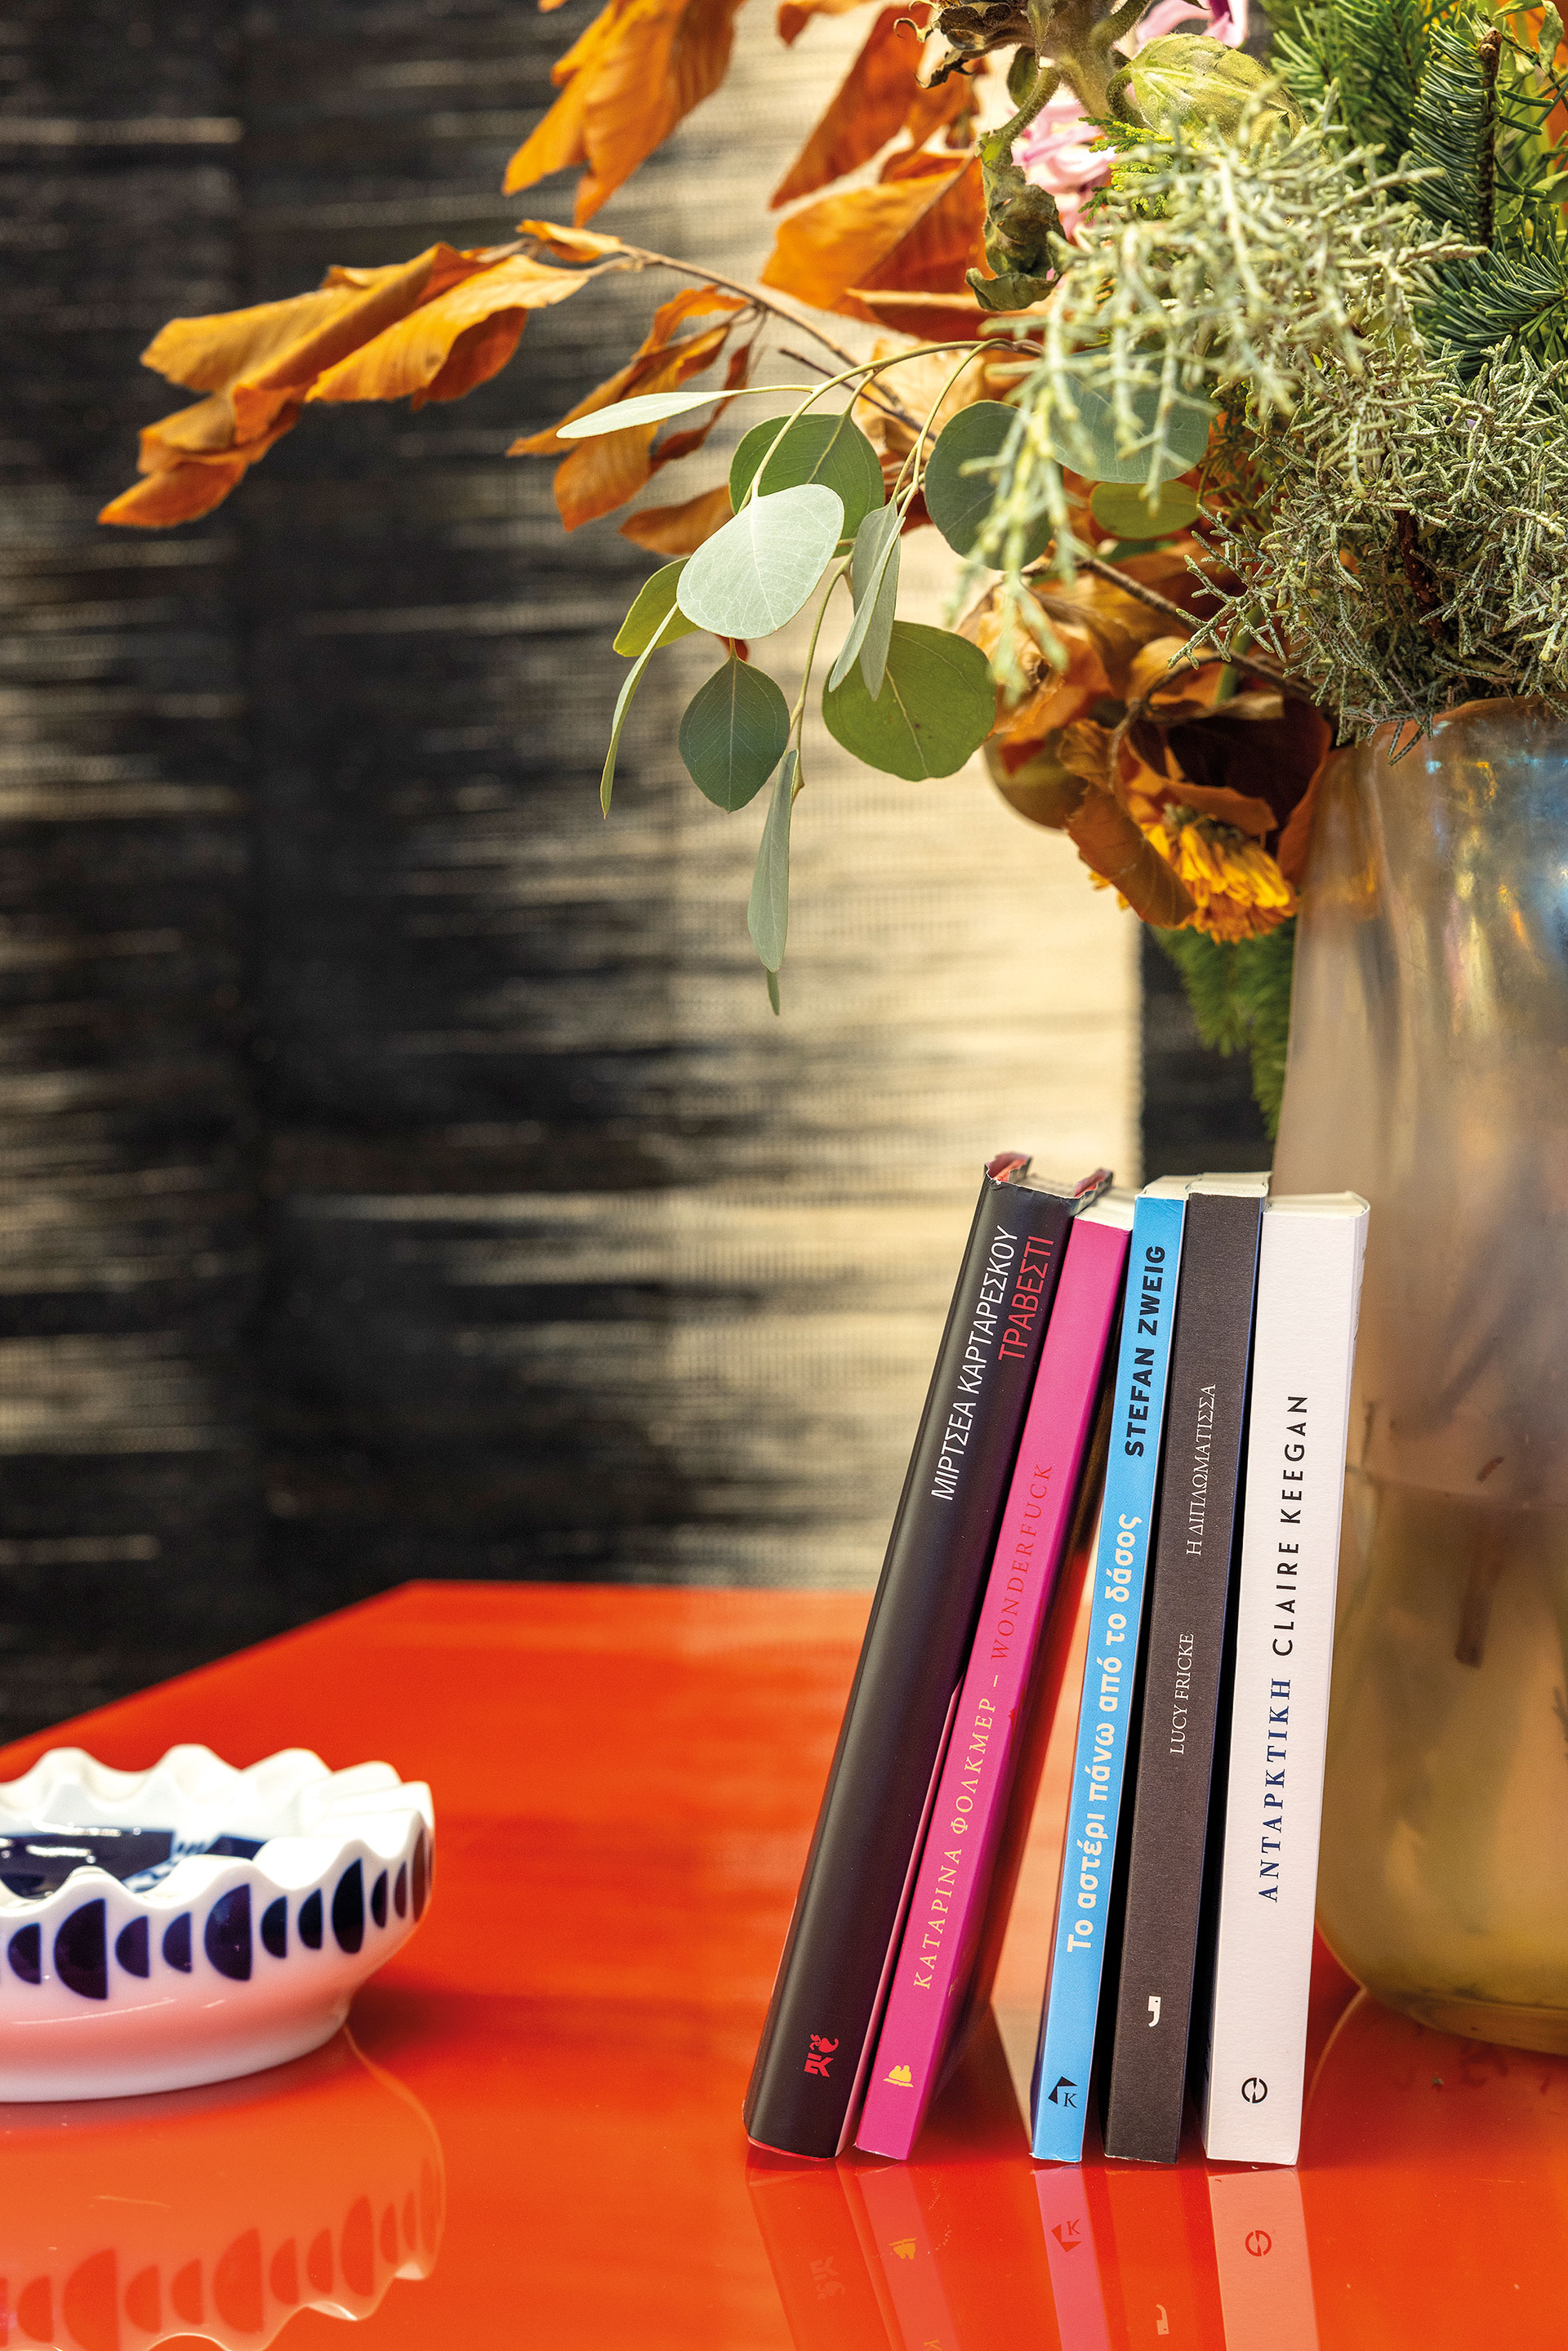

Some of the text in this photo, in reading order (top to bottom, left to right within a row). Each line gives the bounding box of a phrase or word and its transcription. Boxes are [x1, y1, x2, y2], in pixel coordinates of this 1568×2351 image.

[931, 1225, 1018, 1501] ΜΙΡΤΣΕΑ ΚΑΡΤΑΡΕΣΚΟΥ
[998, 1236, 1054, 1360] ΤΡΑΒΕΣΤΙ
[1125, 1245, 1166, 1458] STEFAN ZWEIG
[1187, 1383, 1216, 1556] Η ΔΙΠΛΩΜΑΤΙΣΣΑ
[913, 1849, 963, 1989] ΚΑΤΑΡΙΝΑ
[951, 1698, 996, 1836] ΦΟΛΚΜΕΡ
[990, 1464, 1053, 1661] WONDERFUCK
[1067, 1513, 1143, 1952] Το αστέρι πάνω από το δάσος
[1169, 1632, 1195, 1756] LUCY FRICKE
[1258, 1396, 1308, 1904] ΑΝΤΑΡΚΤΙΚΗ CLAIRE KEEGAN
